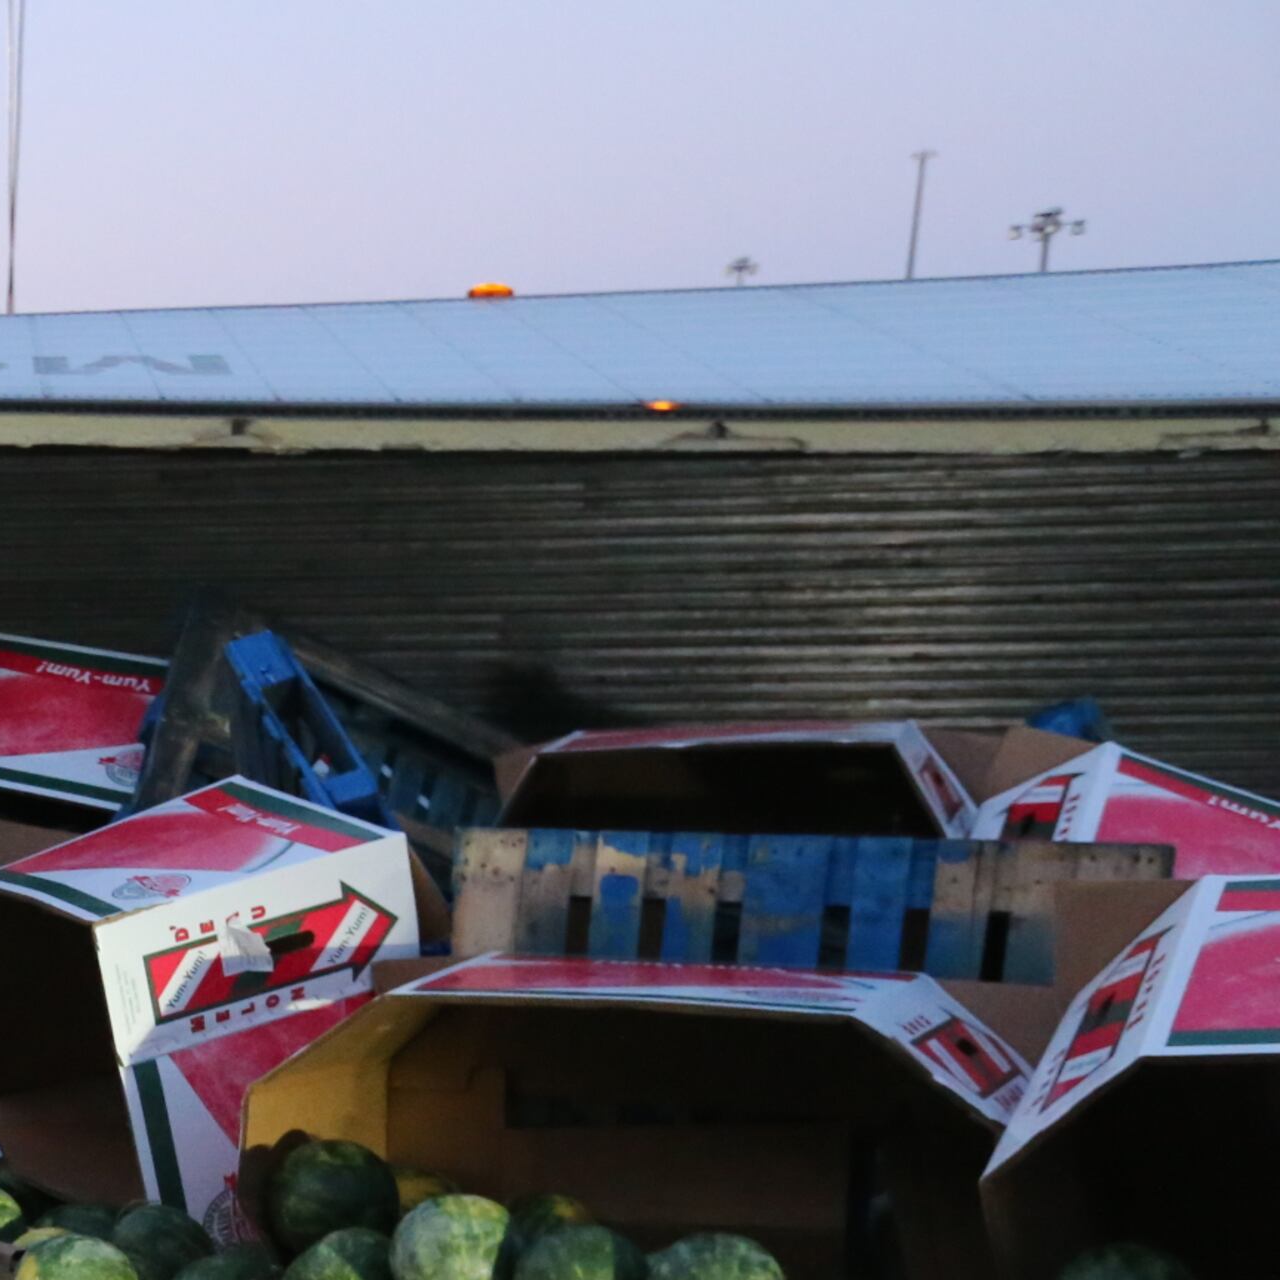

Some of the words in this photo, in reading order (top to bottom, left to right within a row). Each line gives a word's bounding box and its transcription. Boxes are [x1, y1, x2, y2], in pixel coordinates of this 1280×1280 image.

[35, 660, 152, 693] Yum-Yum!
[325, 904, 370, 967] Yum-Yum!
[166, 949, 209, 1013] Yum-Yum!
[190, 985, 307, 1034] MELON
